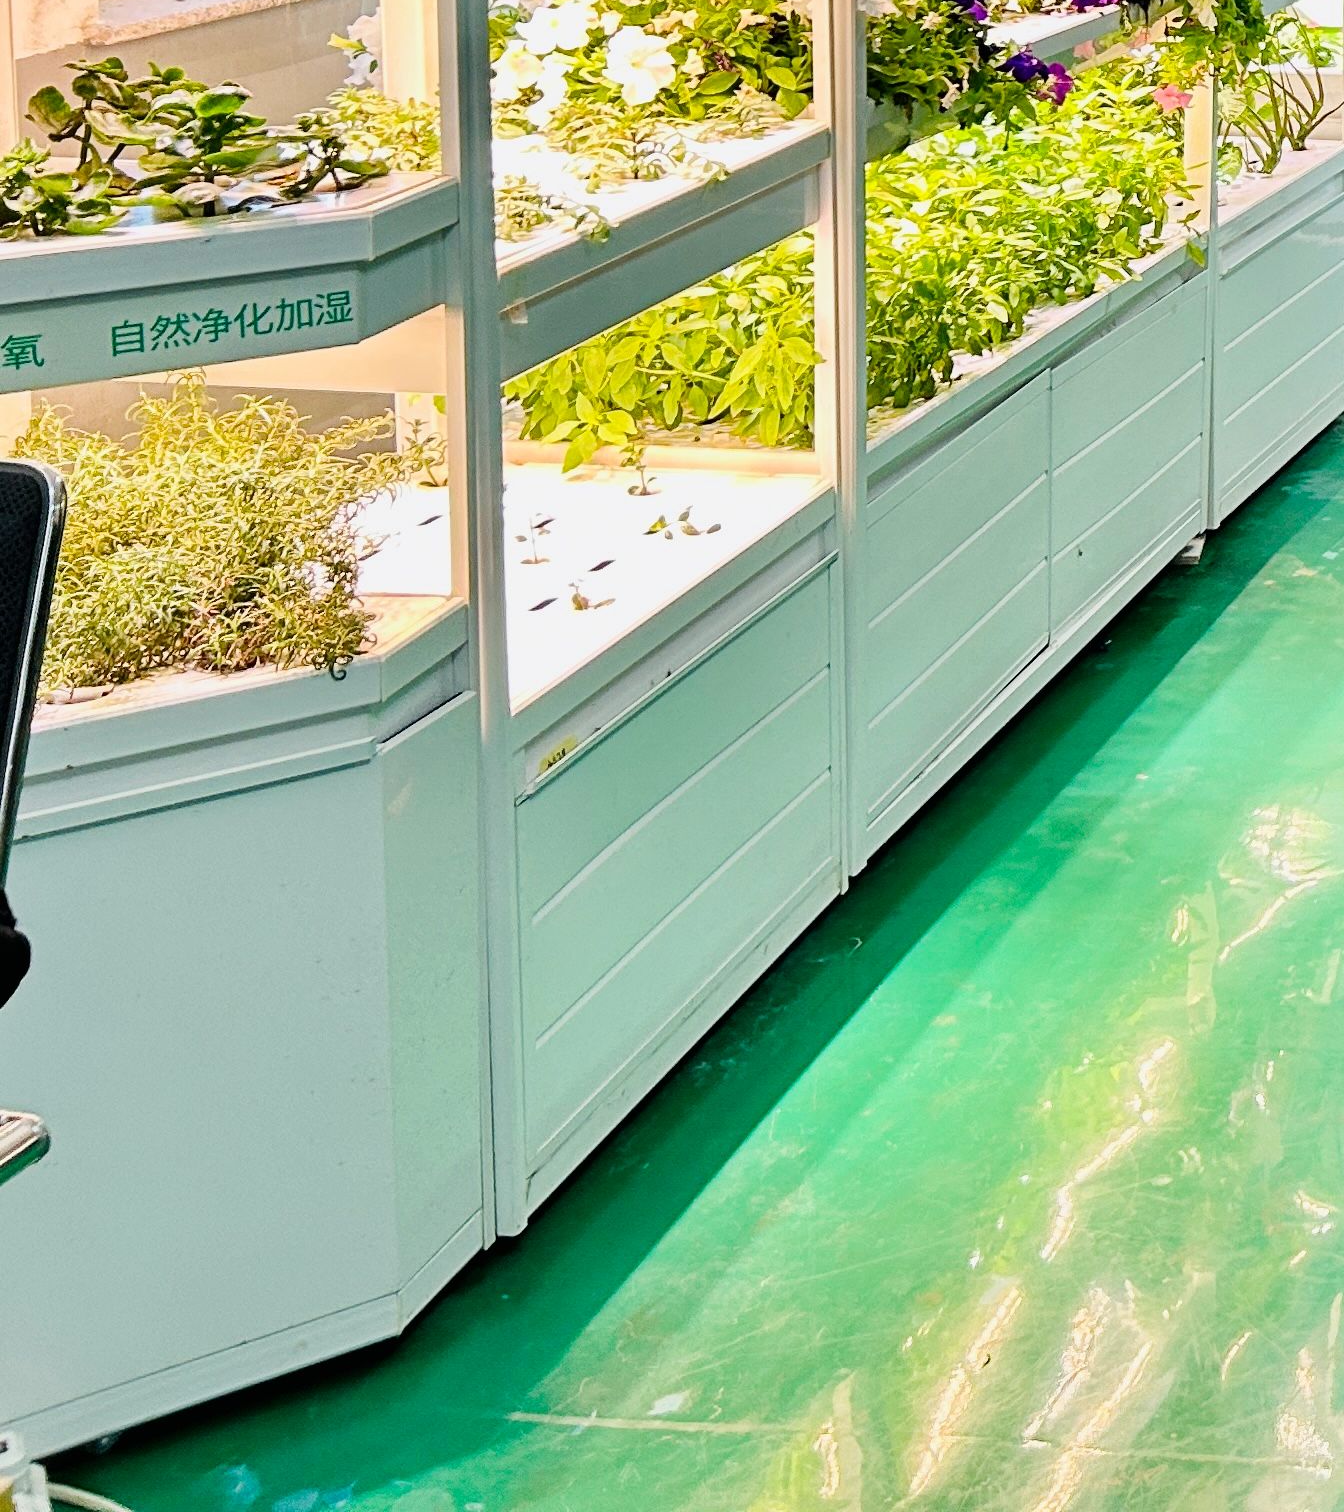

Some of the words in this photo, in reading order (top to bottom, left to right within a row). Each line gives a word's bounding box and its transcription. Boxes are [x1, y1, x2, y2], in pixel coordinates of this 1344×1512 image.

[0, 334, 45, 370] 氧
[111, 289, 354, 356] 自然净化加湿
